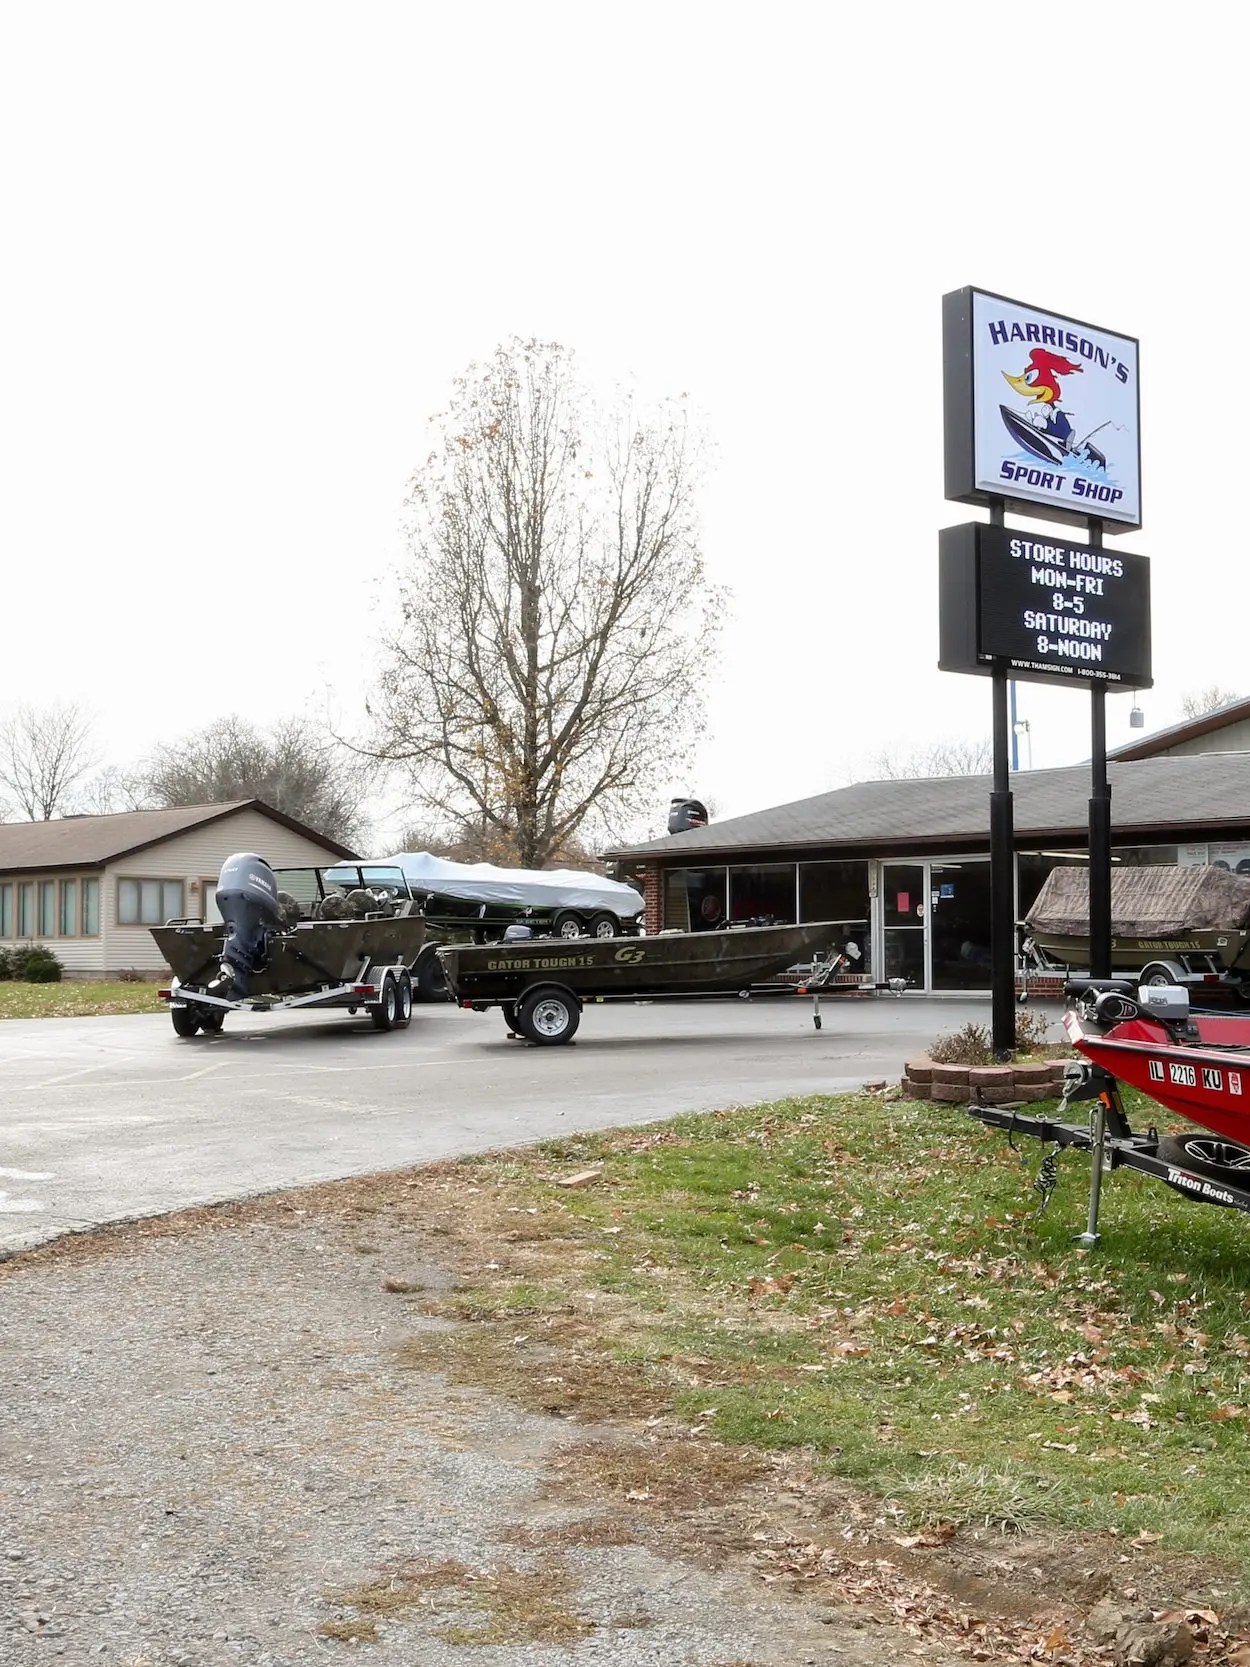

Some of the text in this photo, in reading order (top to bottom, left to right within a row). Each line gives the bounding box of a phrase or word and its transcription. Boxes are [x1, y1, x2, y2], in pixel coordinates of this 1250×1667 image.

[988, 320, 1130, 384] HARRISON'S
[1000, 461, 1123, 503] SPORT SHOP
[1010, 539, 1123, 577] STORE HOURS
[1031, 566, 1104, 596] MON-FRI
[1052, 593, 1084, 614] 8-5
[1024, 611, 1112, 641] SATURDAY
[1037, 636, 1102, 662] 8-NOON
[488, 946, 646, 970] GATOR TOUGH 15 G3
[1150, 1061, 1164, 1080] IL
[1170, 1064, 1195, 1086] 2216
[1202, 1068, 1222, 1089] KU
[1167, 1168, 1202, 1192] Triton
[1202, 1183, 1234, 1204] Boats
